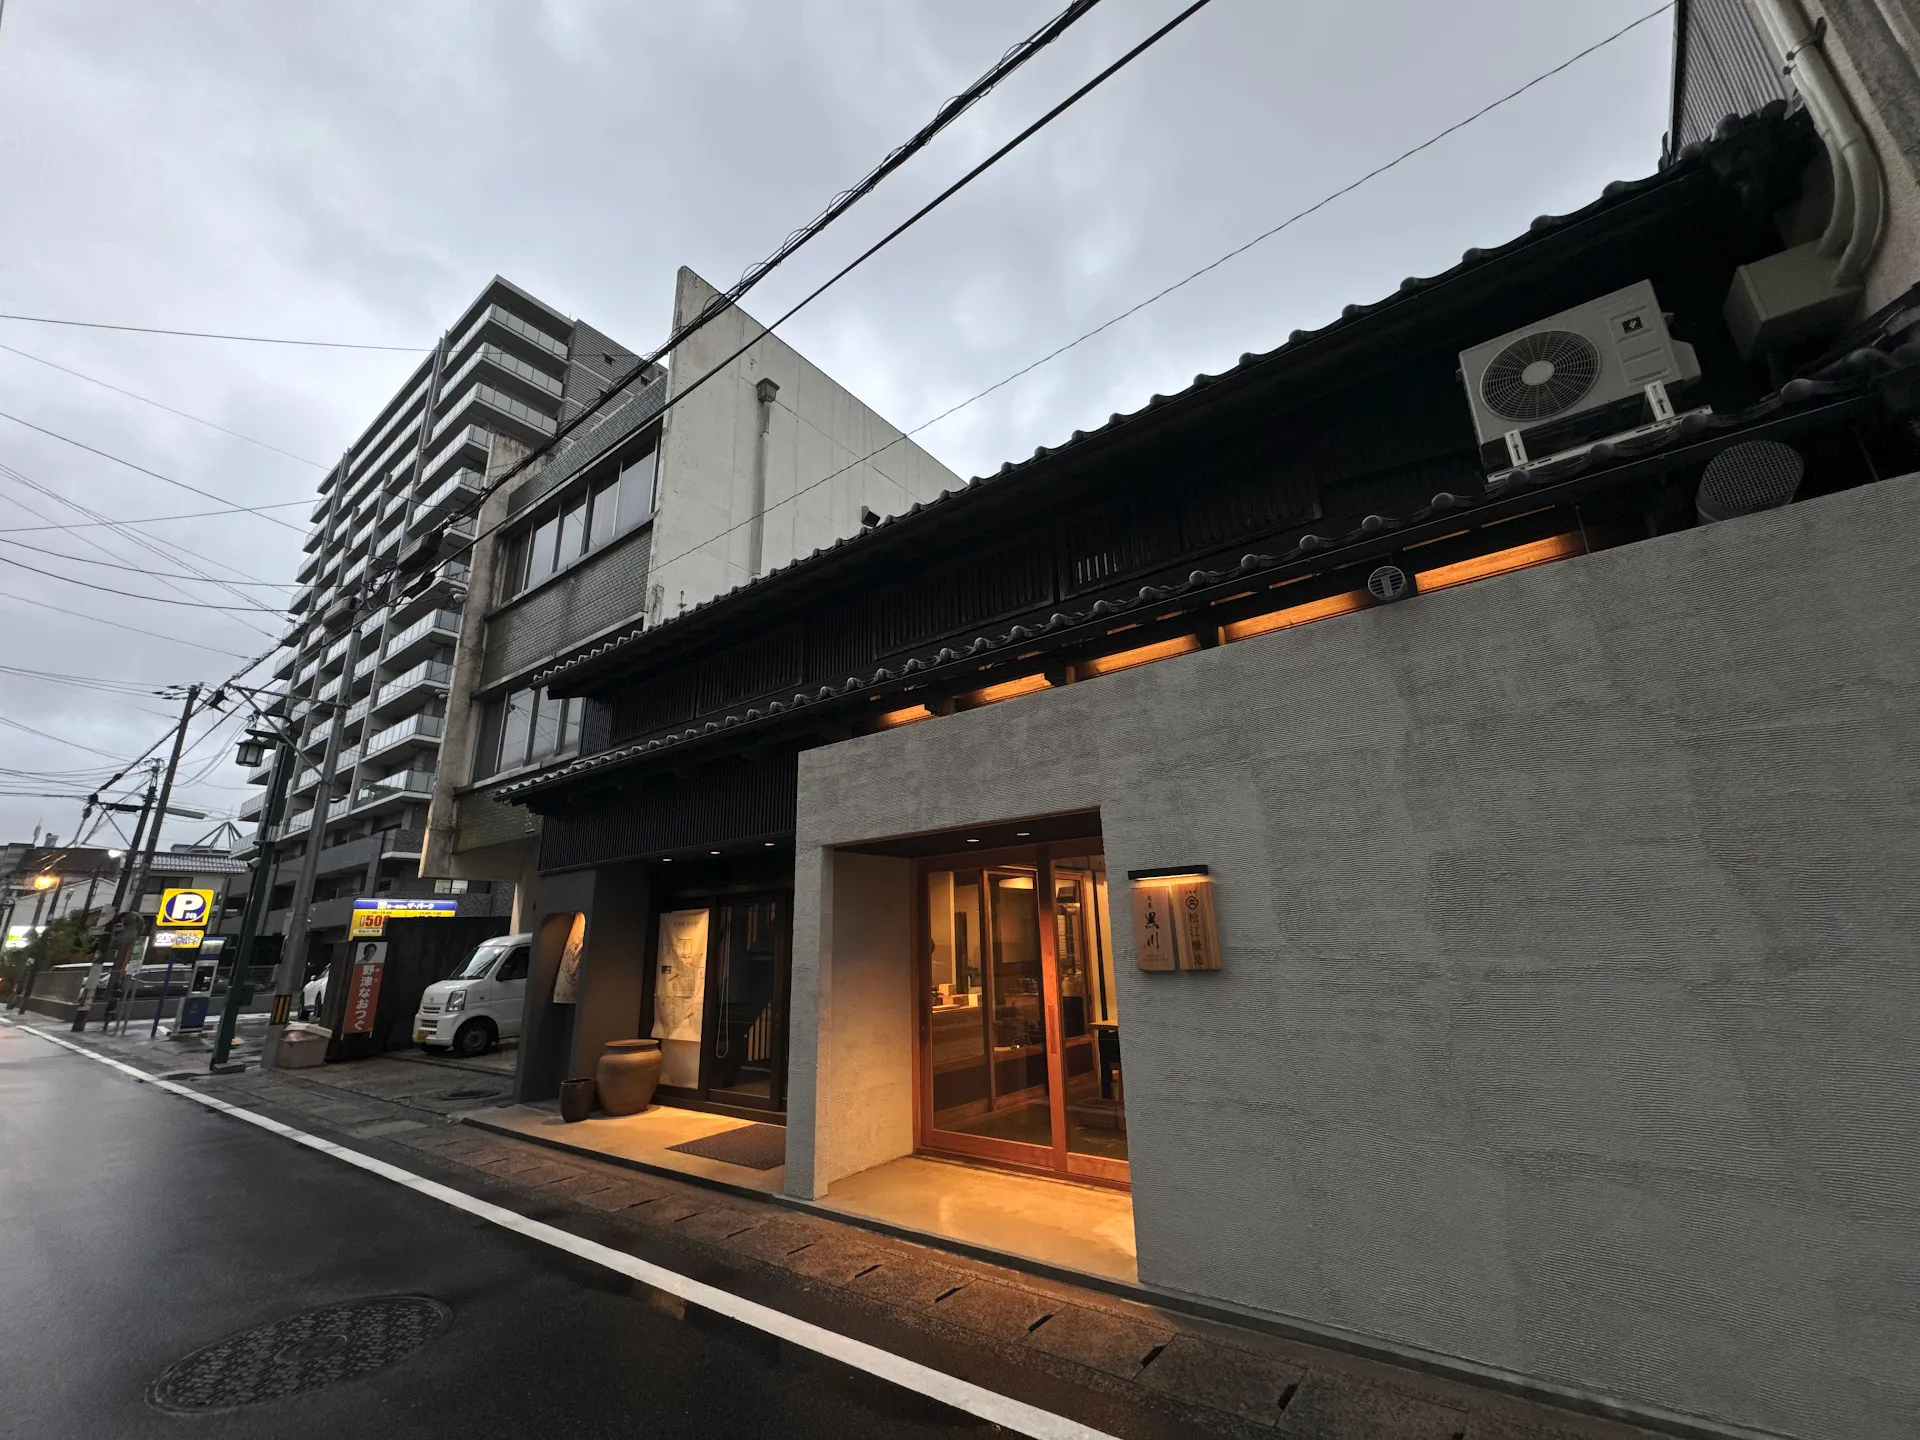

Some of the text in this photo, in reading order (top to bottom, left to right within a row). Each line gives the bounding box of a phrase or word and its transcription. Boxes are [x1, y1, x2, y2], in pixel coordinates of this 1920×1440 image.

[171, 893, 204, 919] P
[354, 964, 376, 1031] 野津なおつぐ
